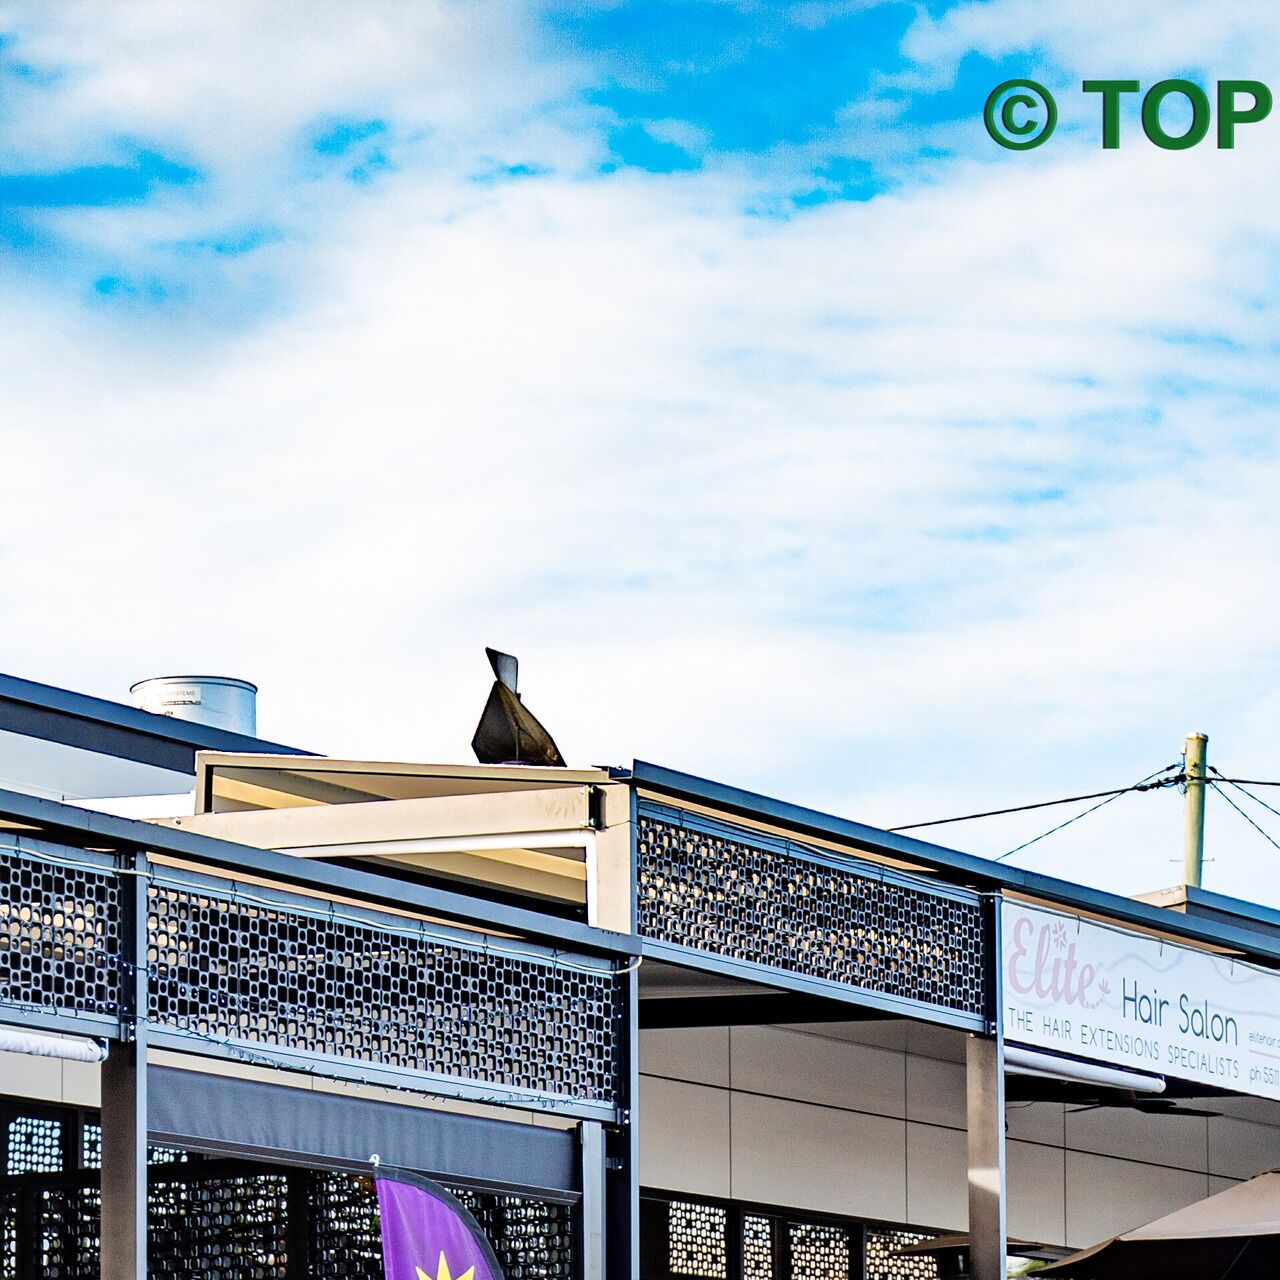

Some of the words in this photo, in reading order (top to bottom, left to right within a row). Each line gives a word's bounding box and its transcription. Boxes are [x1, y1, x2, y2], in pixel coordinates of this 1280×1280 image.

[1007, 916, 1096, 1010] Elite
[1009, 1007, 1033, 1032] THE
[1043, 1014, 1072, 1041] HAIR
[1081, 1024, 1160, 1061] EXTENSIONS
[1167, 1045, 1239, 1079] SPECIALISTS
[1122, 977, 1169, 1027] Hair
[1178, 993, 1238, 1046] Salon
[1250, 1065, 1261, 1085] ph
